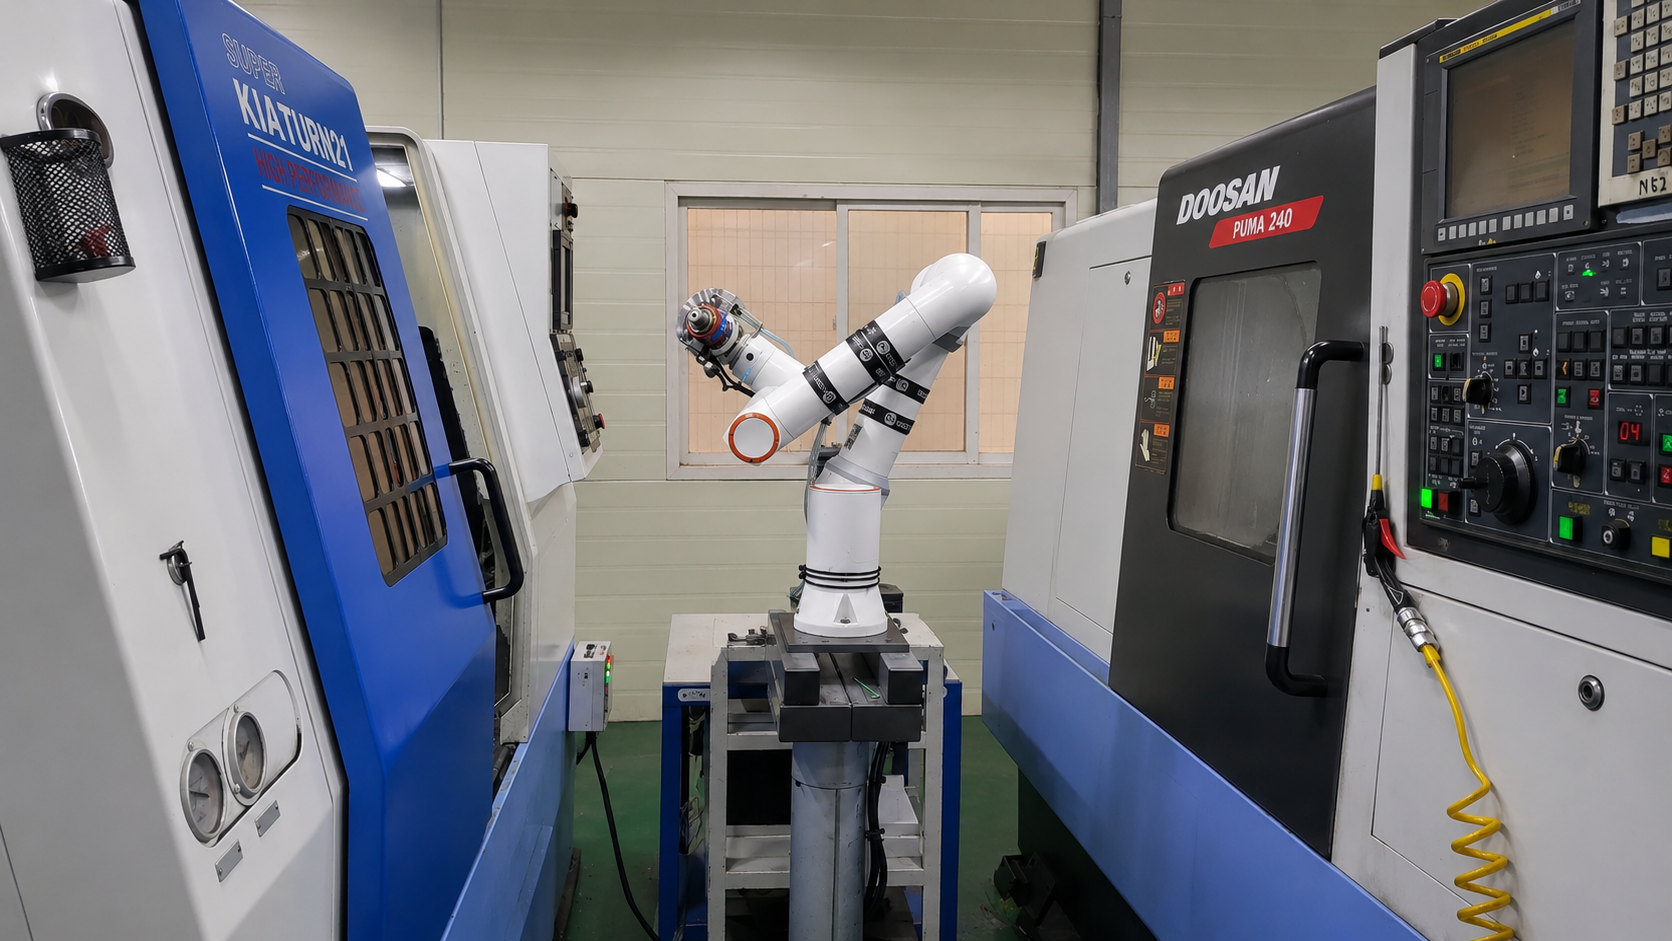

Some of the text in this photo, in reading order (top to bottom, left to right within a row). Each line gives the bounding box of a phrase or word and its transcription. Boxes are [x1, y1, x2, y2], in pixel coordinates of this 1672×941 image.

[222, 33, 285, 95] SUPER
[232, 78, 354, 171] KIATURN21
[253, 147, 365, 212] HIGH PERFORMANCE
[1176, 165, 1281, 225] DOOSAN
[1232, 207, 1293, 239] PUMA 240
[1619, 421, 1640, 441] 04
